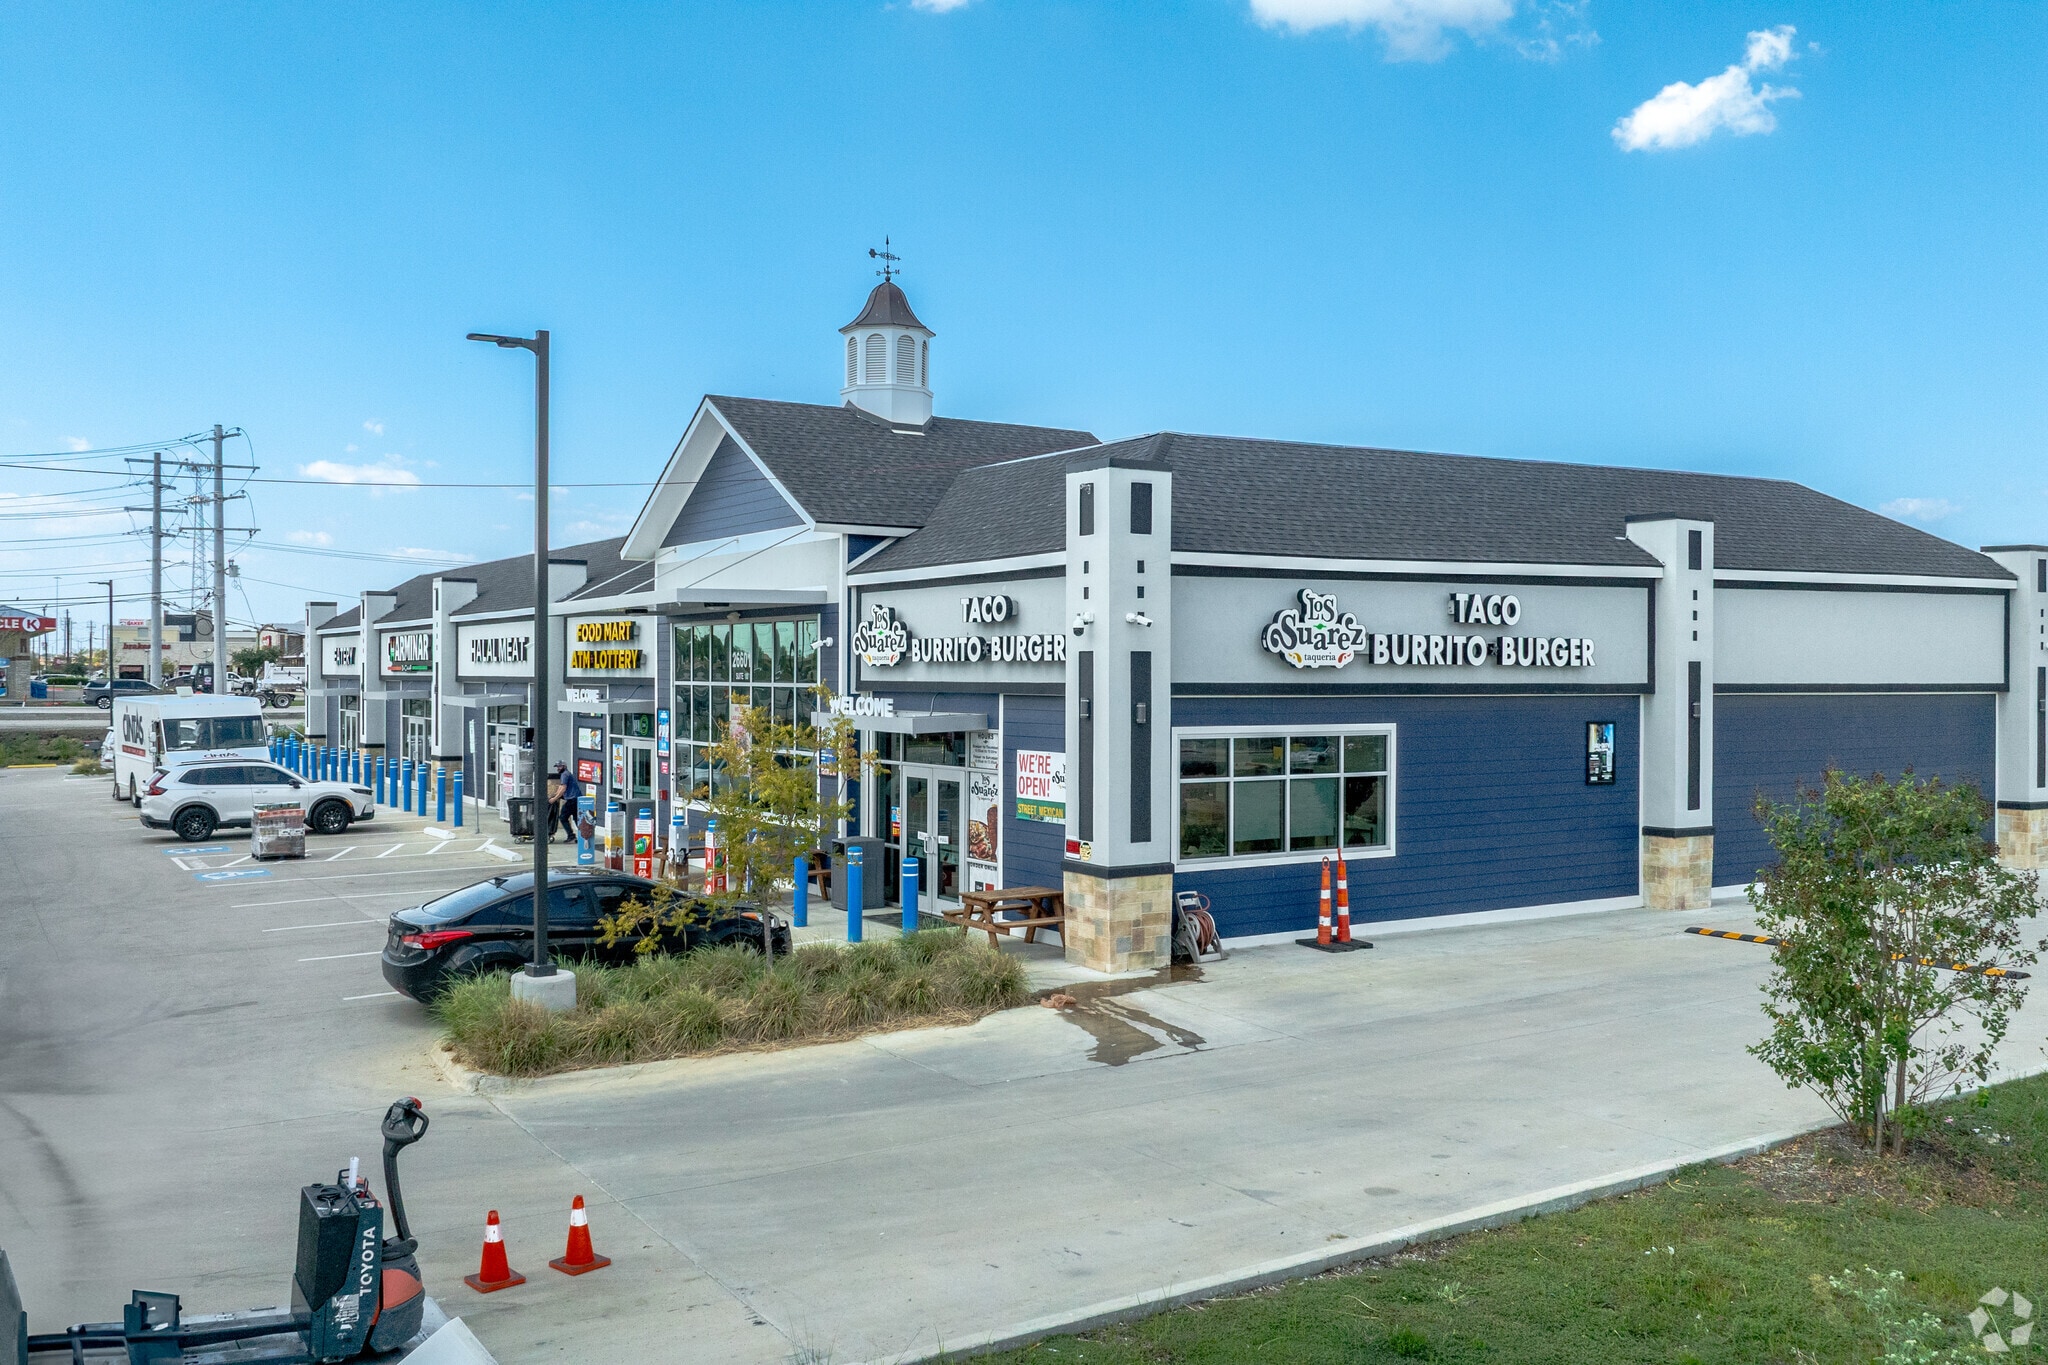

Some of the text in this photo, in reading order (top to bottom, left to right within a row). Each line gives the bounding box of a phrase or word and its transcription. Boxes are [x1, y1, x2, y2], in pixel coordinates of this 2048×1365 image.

[960, 596, 1007, 623] TACO
[1454, 593, 1521, 626] TACO
[576, 621, 632, 642] FOOD MART
[1270, 614, 1364, 650] Suarez
[471, 637, 527, 662] HALAL MEAT
[571, 649, 638, 669] ATM LOTTERY
[911, 634, 1066, 663] BURRITO BURGER
[1304, 652, 1336, 663] taqueria
[1374, 634, 1595, 667] BURRITO BURGER
[829, 696, 894, 717] WELCOME
[1019, 754, 1051, 774] WE'RE
[1018, 776, 1050, 797] OPEN!
[1017, 803, 1037, 815] STREET
[1039, 805, 1064, 818] MEXICAN
[359, 1226, 376, 1297] TOYOTA
